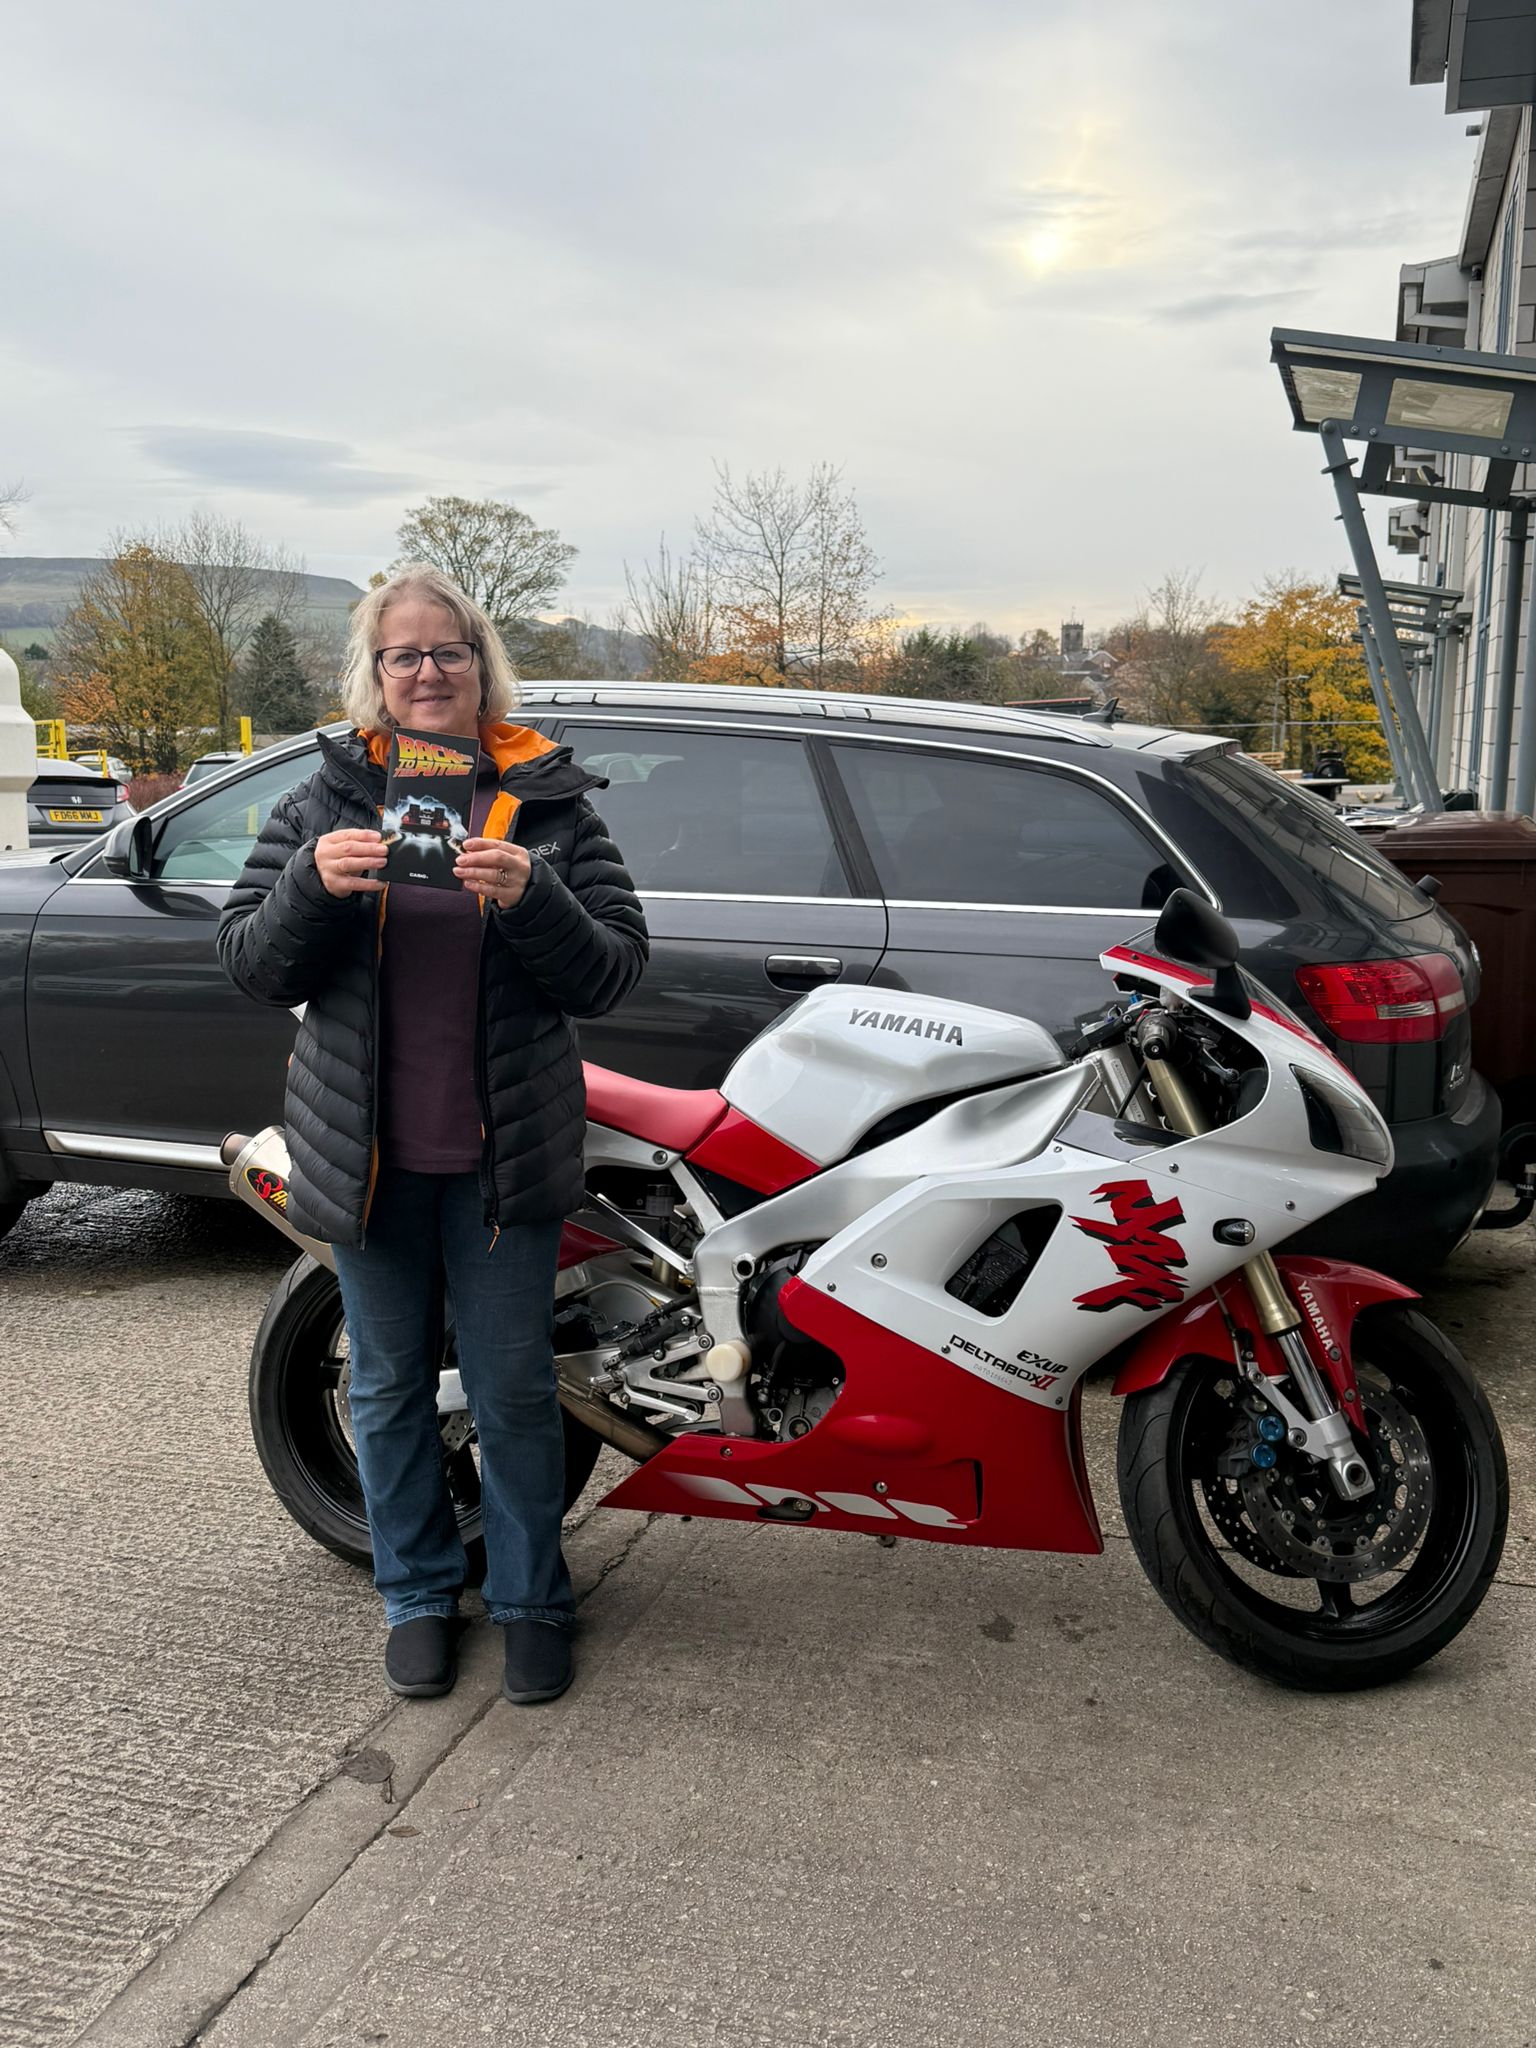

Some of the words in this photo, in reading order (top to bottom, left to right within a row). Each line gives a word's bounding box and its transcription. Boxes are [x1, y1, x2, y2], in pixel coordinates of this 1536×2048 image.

[396, 733, 475, 764] BACK
[399, 759, 416, 769] TO
[529, 841, 561, 856] DEX
[848, 1008, 963, 1047] YAMAHA
[1298, 1280, 1335, 1351] YAMAHA
[1016, 1350, 1069, 1374] EXUP
